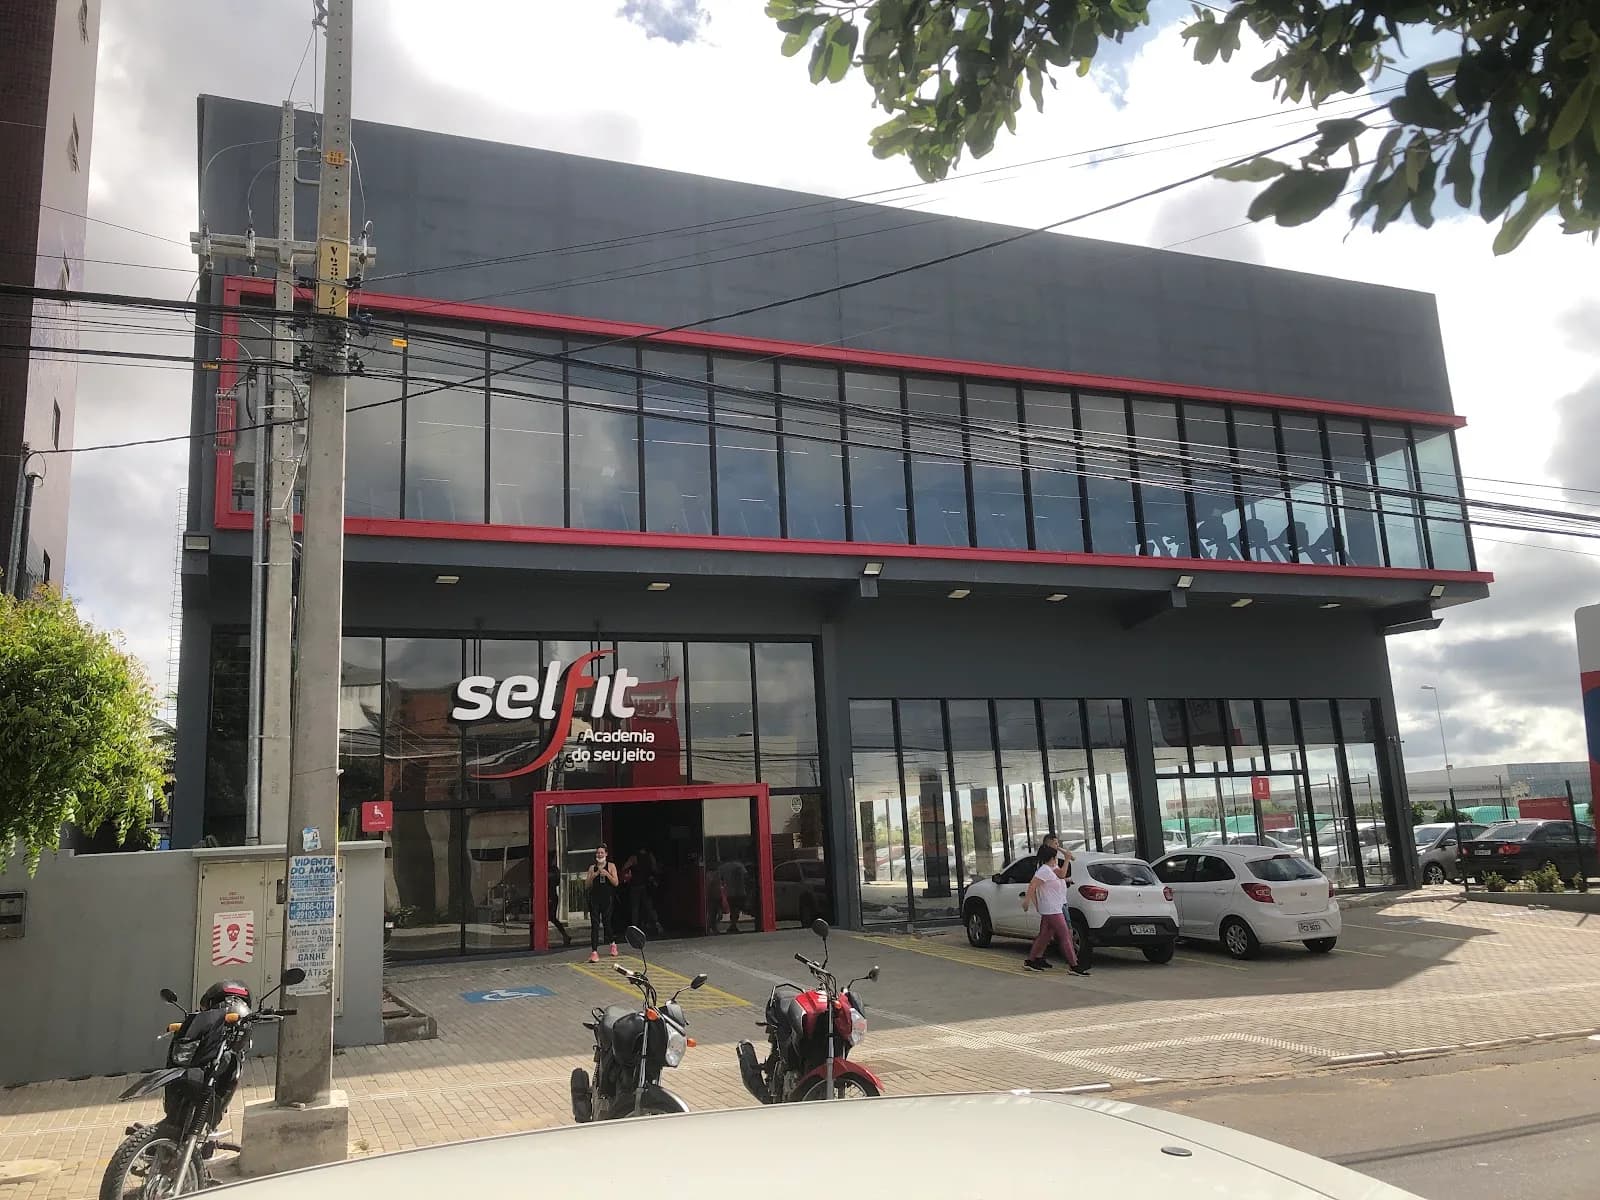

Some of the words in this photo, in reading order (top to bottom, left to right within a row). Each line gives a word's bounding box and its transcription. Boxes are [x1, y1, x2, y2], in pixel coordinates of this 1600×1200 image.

[452, 648, 639, 779] selfit
[583, 729, 655, 743] Academia
[571, 748, 591, 762] do
[593, 751, 621, 762] seu
[621, 748, 656, 764] jeito
[294, 857, 335, 866] VIDENTE
[290, 866, 305, 874] DO
[298, 952, 327, 961] GANHE
